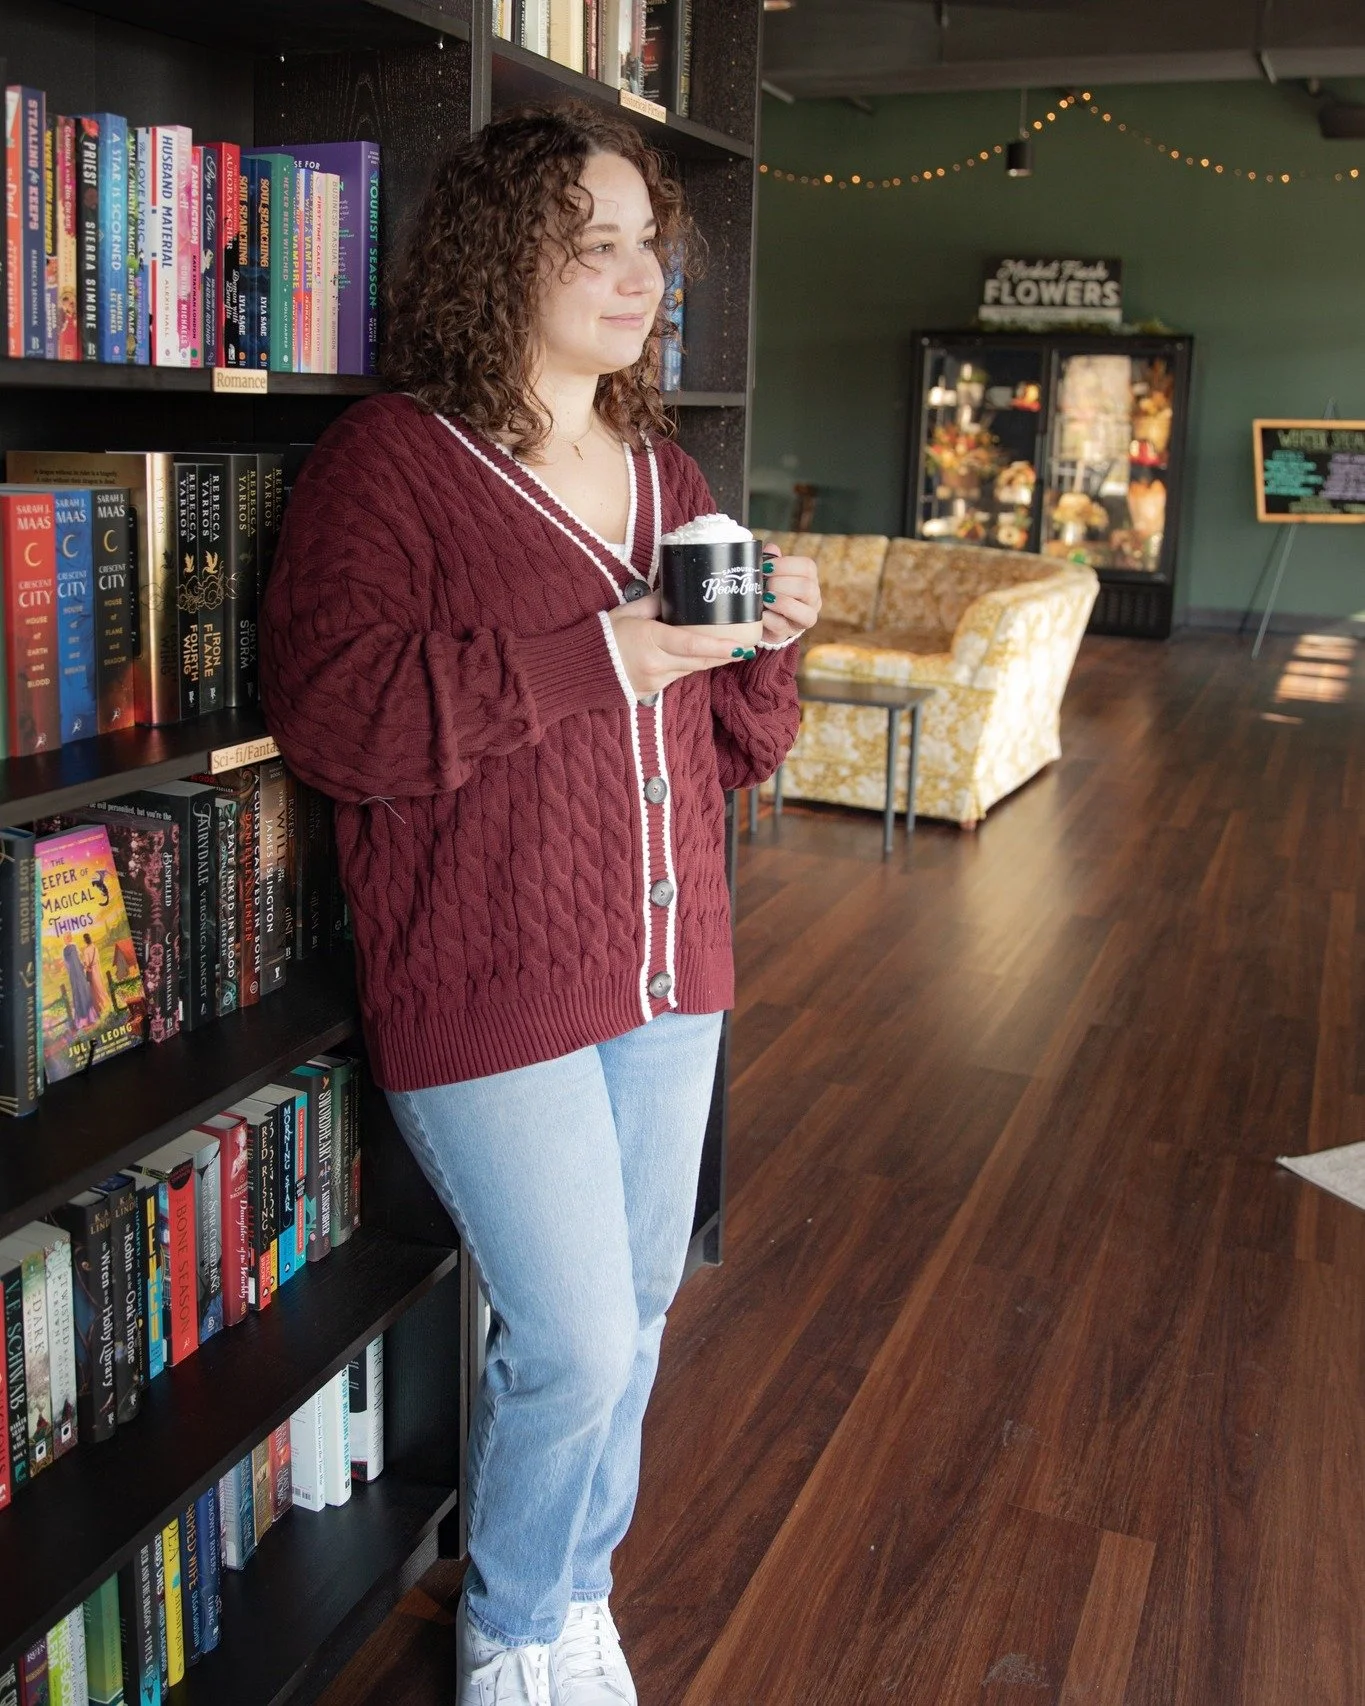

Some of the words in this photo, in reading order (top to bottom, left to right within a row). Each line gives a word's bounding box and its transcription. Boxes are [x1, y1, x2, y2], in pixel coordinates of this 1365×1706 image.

[683, 40, 693, 77] SMITH
[28, 99, 39, 168] STEALING
[112, 132, 121, 143] A
[83, 141, 97, 187] PRIEST
[112, 149, 121, 181] STAR
[138, 160, 146, 198] LOVE
[161, 136, 173, 200] HUSBAND
[191, 165, 199, 197] FANG
[226, 153, 234, 202] AURORA
[304, 160, 321, 170] FOR
[28, 186, 39, 230] KEEPS
[112, 187, 121, 198] IS
[239, 176, 248, 203] SOUL
[260, 178, 270, 208] SOUL
[282, 176, 290, 208] NEVER
[331, 182, 339, 227] BUSINESS
[138, 201, 146, 243] LYRIC
[191, 198, 199, 246] FICTION
[226, 205, 234, 250] ASCHER
[282, 210, 290, 236] BEEN
[369, 177, 379, 242] TOURIST
[85, 221, 96, 271] SIERRA
[111, 203, 122, 272] SCORNED
[161, 206, 173, 269] MATERIAL
[239, 205, 248, 267] SEARCHING
[258, 207, 270, 268] SEARCHING
[331, 231, 339, 266] CASUAL
[282, 238, 290, 282] WITCHED
[304, 235, 312, 290] VAMPIRE
[369, 247, 379, 305] SEASON
[85, 278, 96, 330] SIMONE
[224, 280, 234, 319] Benefits
[231, 269, 241, 304] Demon
[238, 294, 247, 314] LYLA
[985, 279, 1120, 306] FLOWERS
[181, 303, 189, 347] MICHAELS
[231, 306, 240, 324] with
[259, 296, 268, 316] LYLA
[238, 315, 247, 336] SAGE
[259, 317, 268, 338] SAGE
[216, 371, 267, 390] Romance
[16, 504, 41, 514] SARAH
[56, 499, 79, 509] SARAH
[56, 509, 88, 524] MAAS
[97, 494, 120, 504] SARAH
[97, 504, 126, 519] MAAS
[179, 479, 188, 538] YARROS
[189, 473, 197, 542] REBECCA
[202, 480, 210, 537] YARROS
[212, 475, 220, 542] REBECCA
[239, 475, 247, 531] YARROS
[275, 468, 283, 534] REBECCA
[17, 515, 52, 531] MAAS
[18, 590, 53, 608] CITY
[57, 581, 88, 599] CITY
[98, 573, 128, 591] CITY
[702, 578, 740, 602] Book
[105, 627, 124, 636] FLAME
[203, 623, 214, 678] FLAME
[213, 632, 222, 666] IRON
[240, 619, 250, 669] STORM
[249, 623, 257, 662] ONYX
[104, 655, 127, 666] SHADOW
[183, 634, 191, 675] WING
[190, 624, 199, 682] FOURTH
[27, 677, 51, 689] BLOOD
[213, 742, 278, 770] Sci-fi/Fanta
[254, 774, 261, 784] A
[97, 802, 107, 810] evil
[136, 807, 146, 816] but
[162, 812, 172, 821] the
[227, 819, 235, 827] A
[193, 803, 211, 887] FAIRYDALE
[227, 834, 236, 864] FATE
[245, 813, 253, 876] DANIELLE
[265, 819, 274, 858] JAMES
[276, 810, 286, 866] WILL
[20, 859, 30, 891] LOST
[50, 857, 65, 868] THE
[79, 867, 90, 877] OF
[41, 887, 96, 914] MAGICAL
[227, 869, 236, 911] INKED
[266, 863, 274, 933] ISLINGTON
[20, 897, 30, 946] HOURS
[49, 912, 94, 938] THINGS
[199, 890, 207, 951] VERONICA
[227, 916, 236, 931] IN
[254, 911, 261, 929] IN
[227, 936, 236, 979] BLOOD
[100, 1022, 134, 1044] LEONG
[283, 1105, 294, 1170] MORNING
[318, 1089, 332, 1163] SWORDHEART
[261, 1164, 269, 1231] RISING
[284, 1175, 294, 1212] STAR
[176, 1203, 188, 1254] BONE
[235, 1200, 249, 1244] Daughter
[124, 1231, 135, 1273] Robin
[235, 1245, 248, 1255] of
[100, 1250, 112, 1290] Wren
[209, 1267, 221, 1295] KING
[61, 1280, 71, 1346] TWISTED
[125, 1290, 137, 1321] Oak
[178, 1260, 191, 1335] SEASON
[32, 1299, 44, 1356] DARK
[100, 1303, 114, 1341] Holly
[126, 1321, 136, 1365] Throne
[8, 1321, 25, 1410] SCHWAB
[99, 1340, 114, 1388] Library
[207, 1499, 215, 1537] DROWN
[187, 1551, 199, 1591] WIFE
[209, 1539, 217, 1575] RIVERS
[156, 1567, 165, 1595] ONES
[142, 1596, 152, 1630] DRAGON
[191, 1591, 200, 1615] OLGA
[207, 1595, 215, 1626] LIANG
[193, 1615, 201, 1648] GRUSHIN
